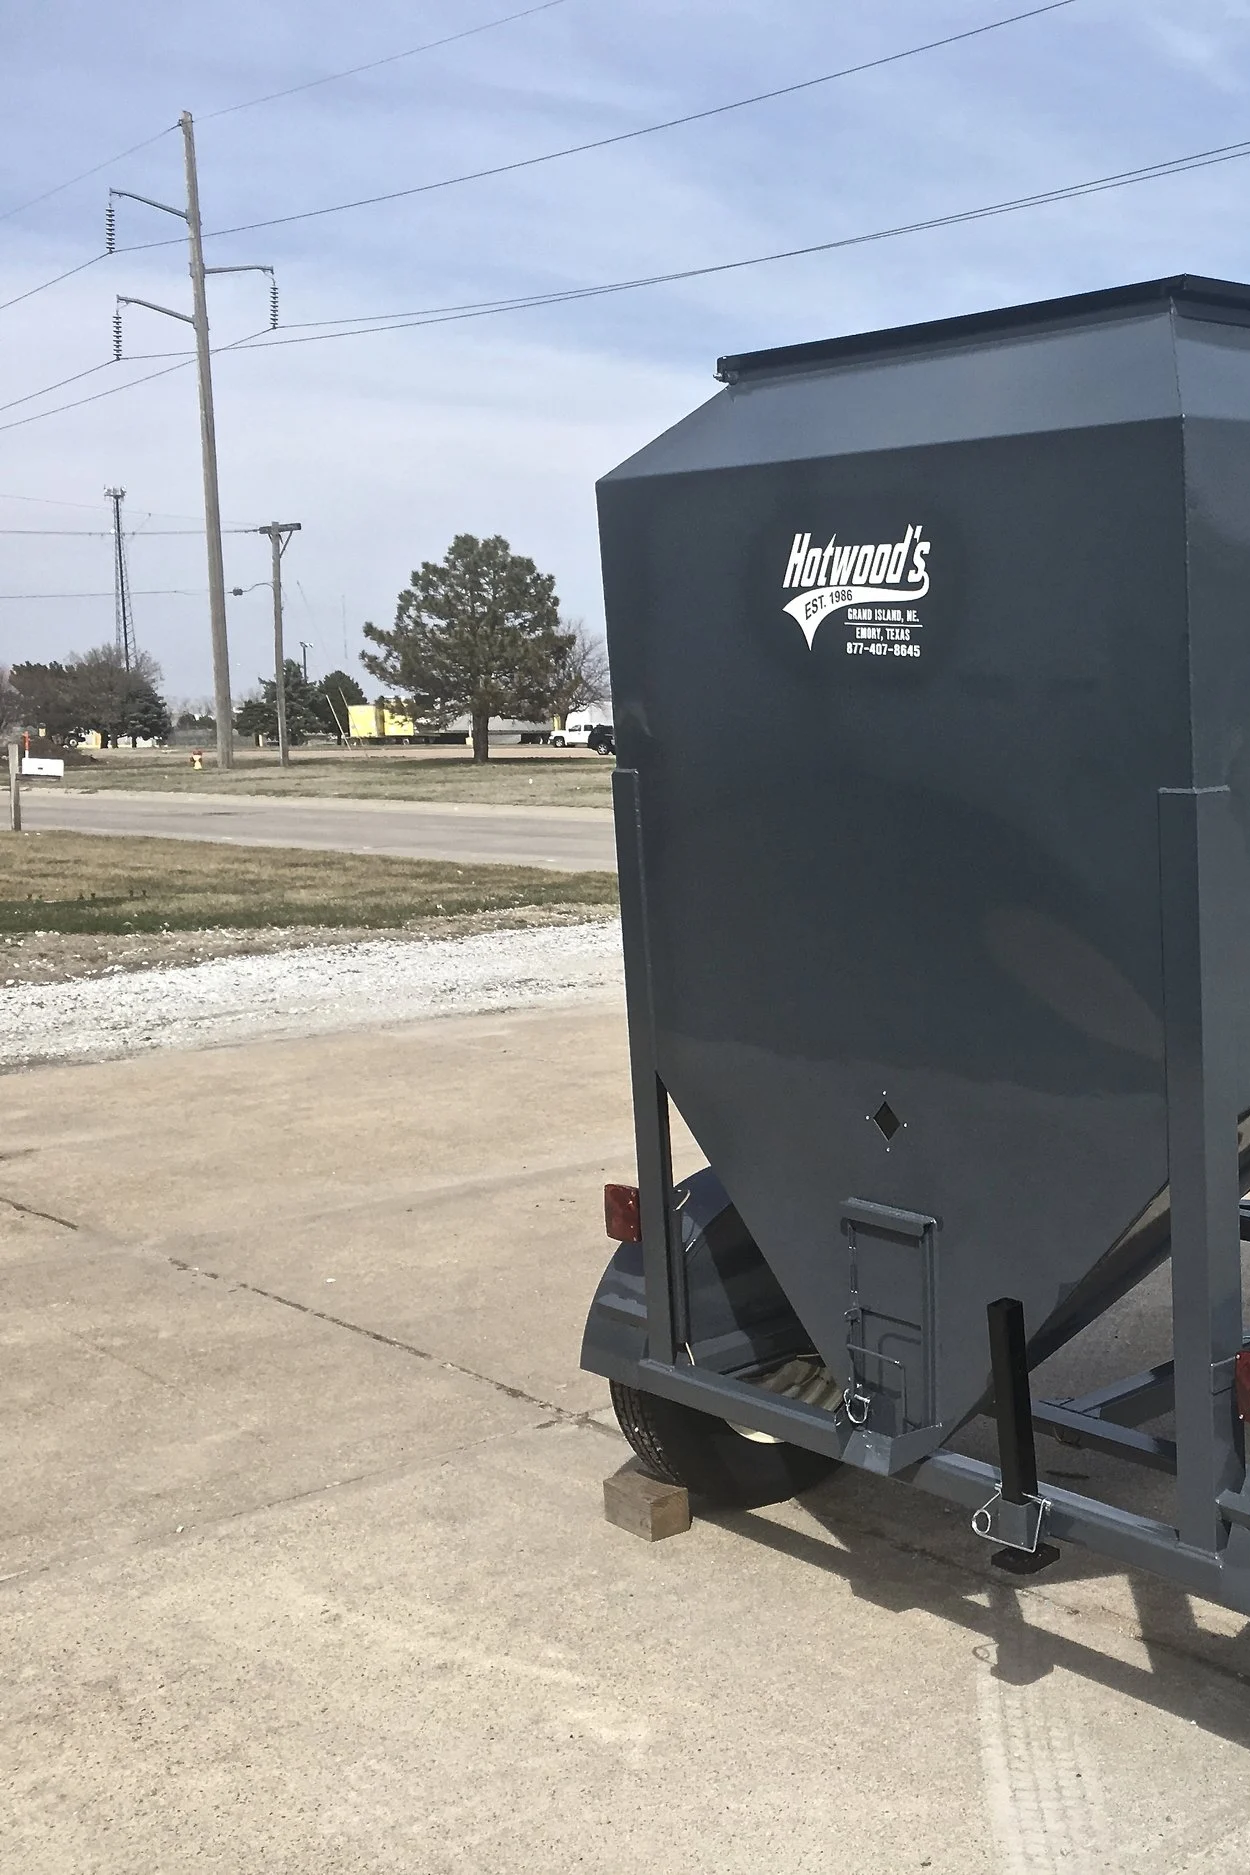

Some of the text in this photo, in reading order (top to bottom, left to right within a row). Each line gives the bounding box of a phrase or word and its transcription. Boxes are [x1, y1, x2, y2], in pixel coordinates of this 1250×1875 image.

[782, 523, 931, 588] Hotwood's
[804, 589, 853, 620] EST. 1986
[847, 608, 920, 623] GRAND ISLAND, NE.
[855, 627, 911, 641] EMORY, TEXAS
[846, 641, 921, 657] 877-407-8645
